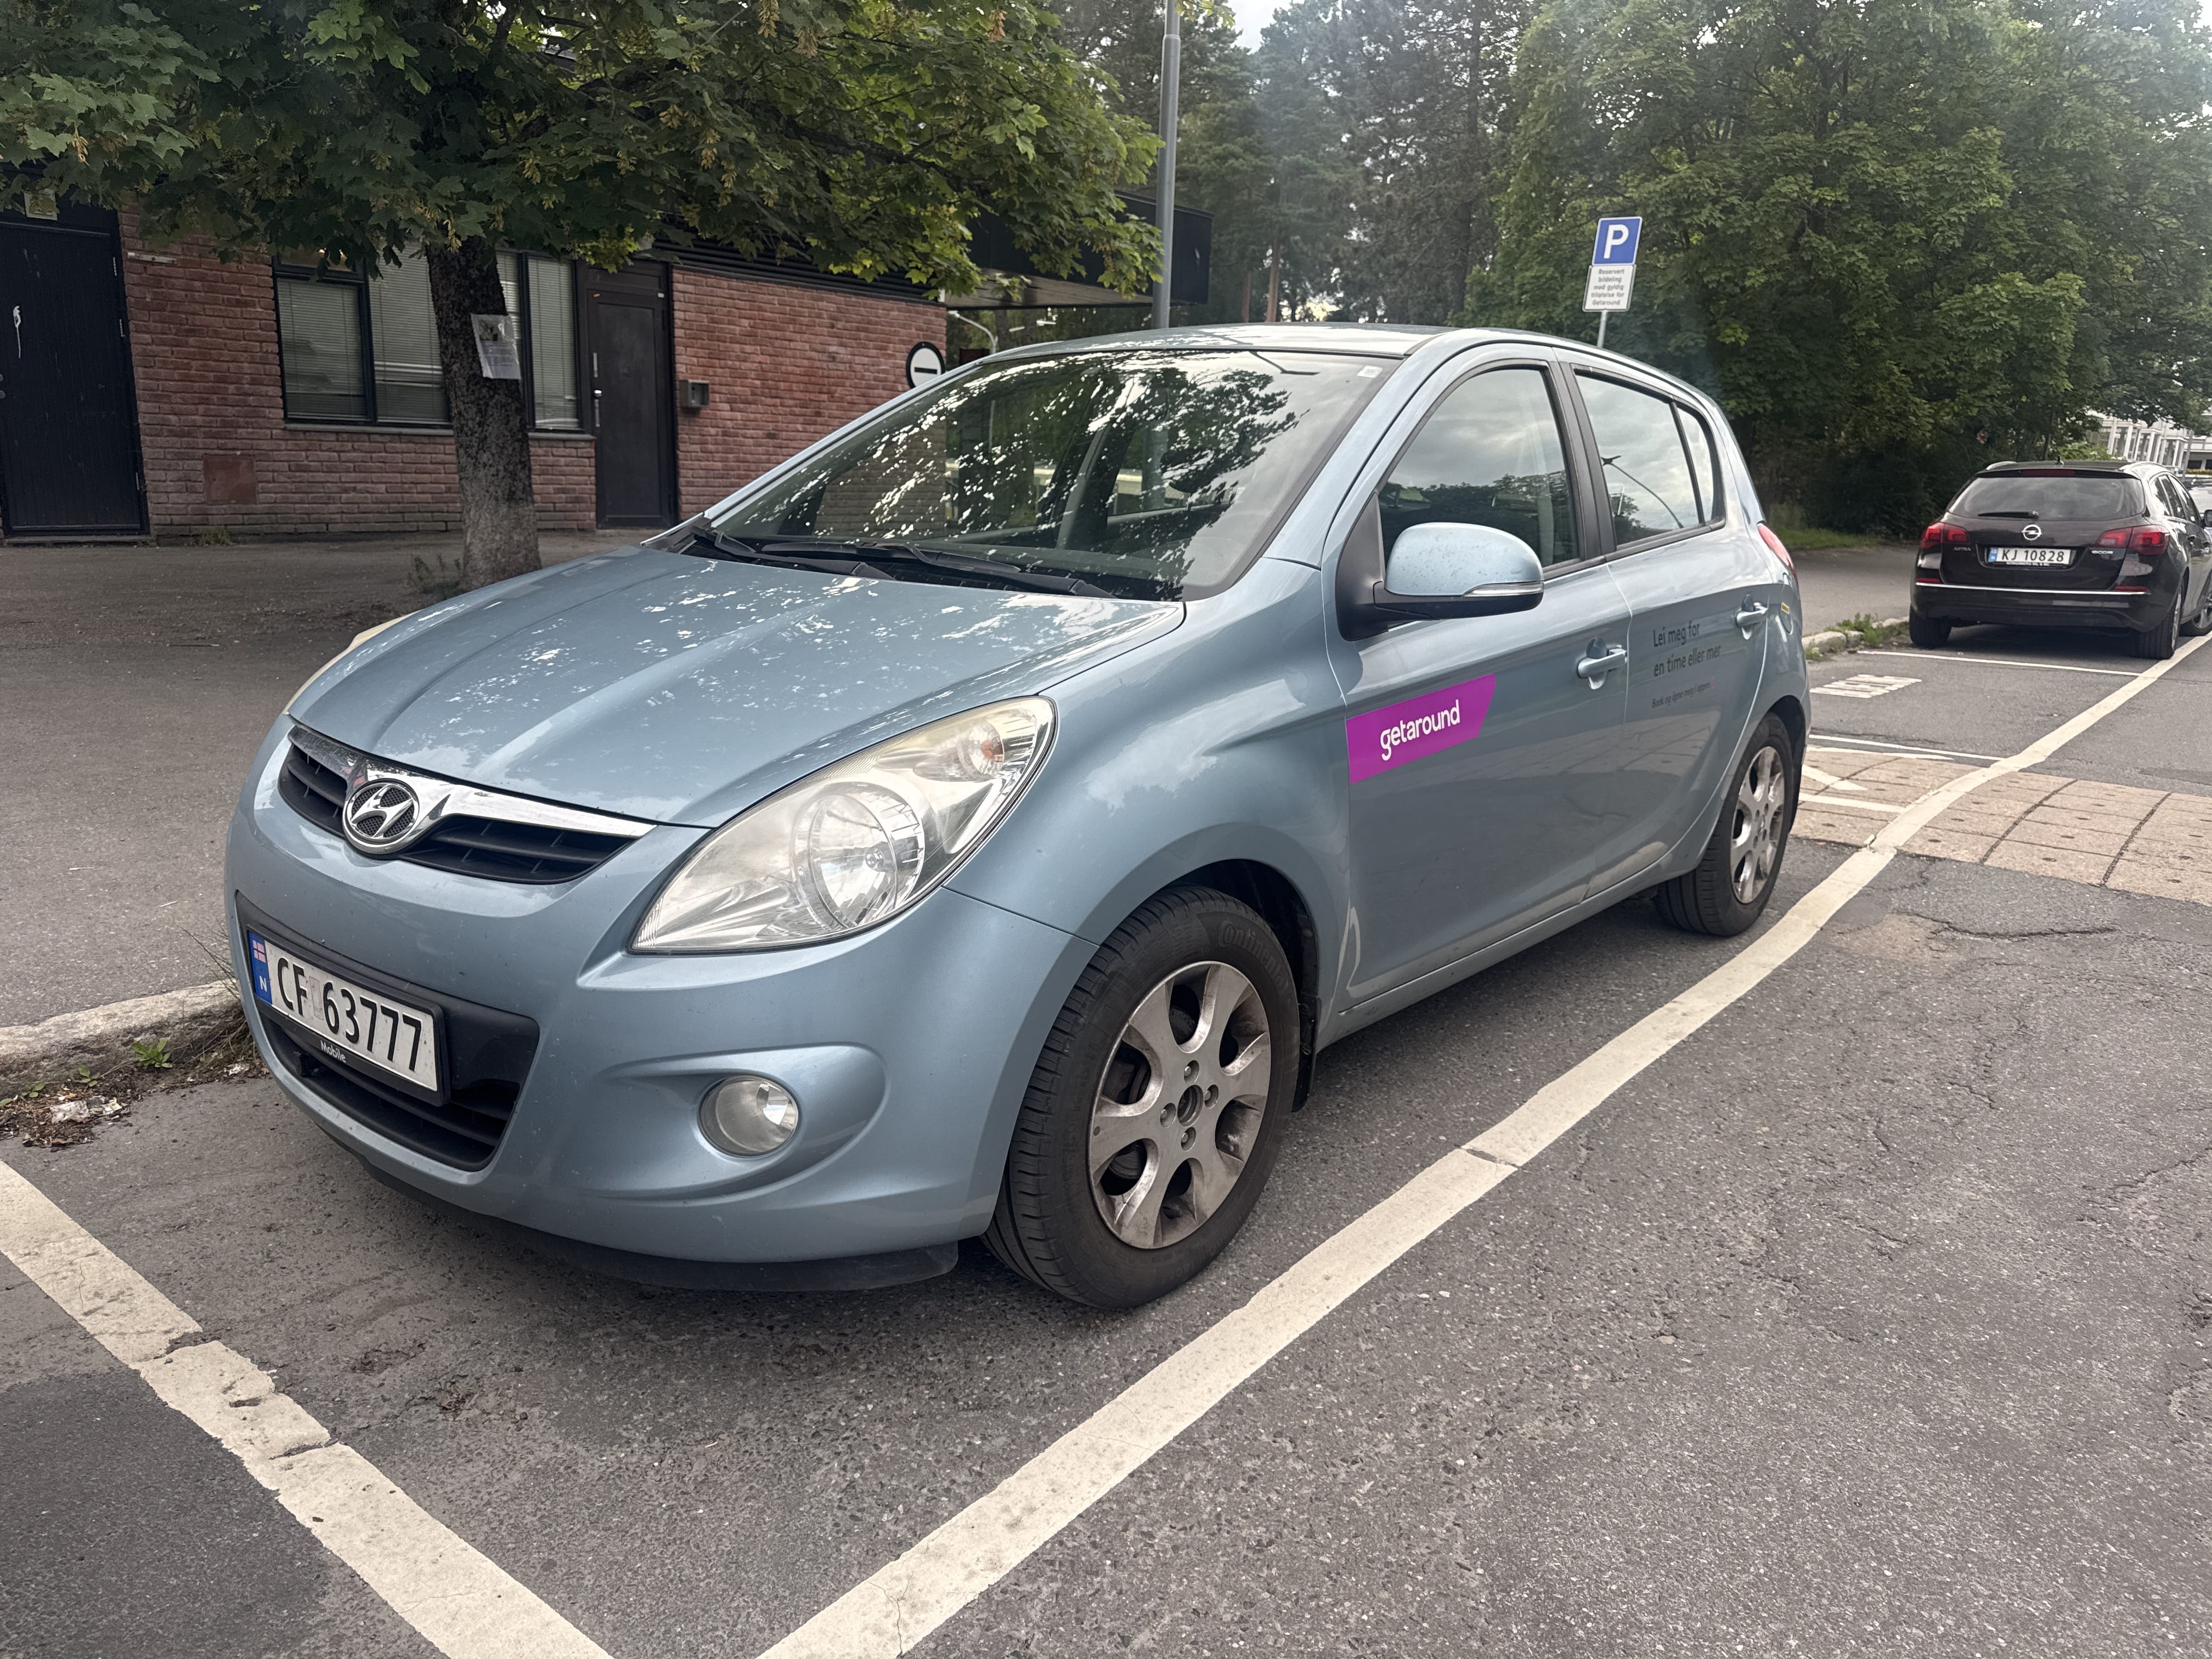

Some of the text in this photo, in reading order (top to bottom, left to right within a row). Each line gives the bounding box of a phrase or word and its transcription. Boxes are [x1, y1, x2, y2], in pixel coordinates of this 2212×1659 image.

[1603, 224, 1629, 259] P
[2002, 550, 2064, 562] KJ 10828
[1653, 620, 1700, 647] Lei meg for
[1654, 645, 1721, 676] en time eller mer
[1380, 699, 1460, 761] getaround
[1218, 920, 1289, 995] Continental
[259, 974, 268, 993] N
[277, 956, 422, 1073] CF 63777
[320, 1039, 347, 1063] Mobile
